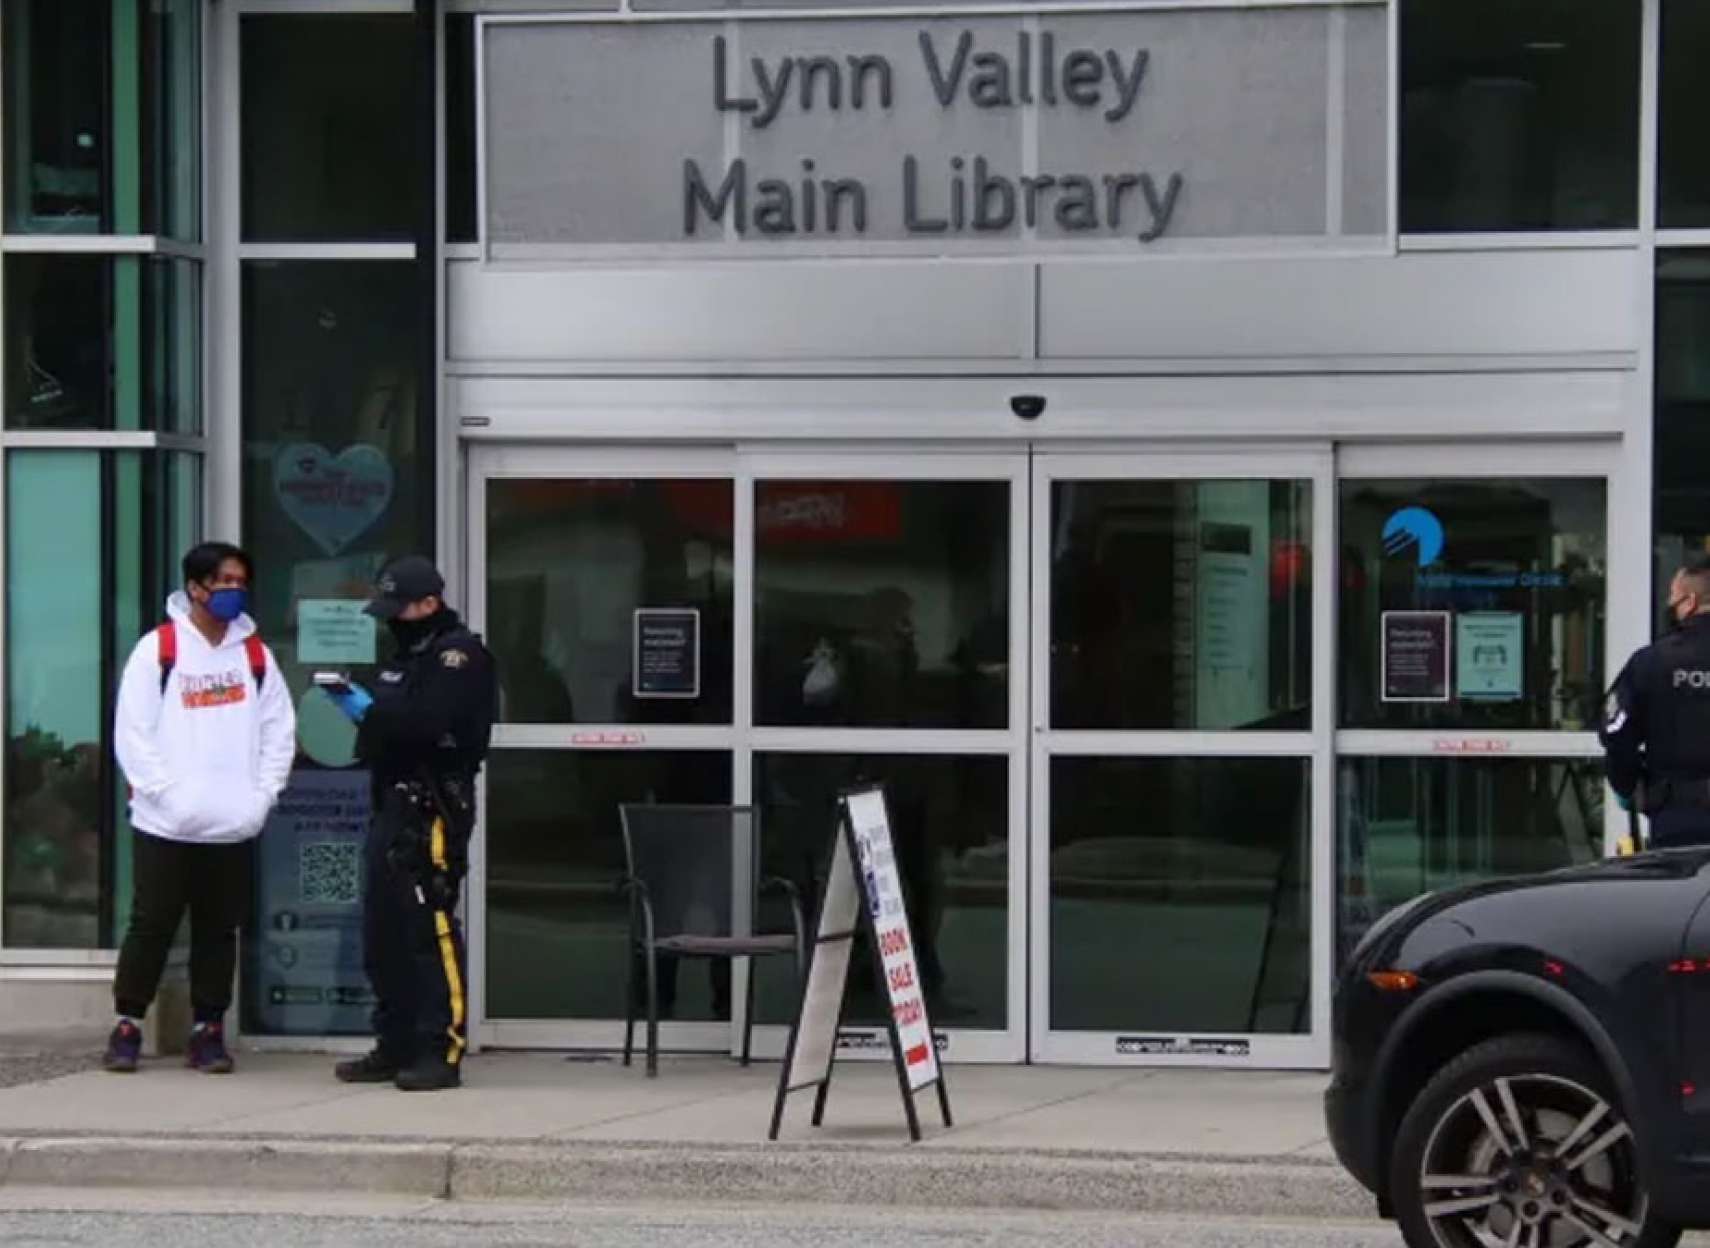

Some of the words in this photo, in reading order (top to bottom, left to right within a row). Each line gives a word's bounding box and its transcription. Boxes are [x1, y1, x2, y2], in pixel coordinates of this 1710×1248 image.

[713, 34, 892, 128] Lynn
[917, 30, 1150, 122] Valley
[683, 157, 867, 236] Main
[903, 154, 1184, 242] Library
